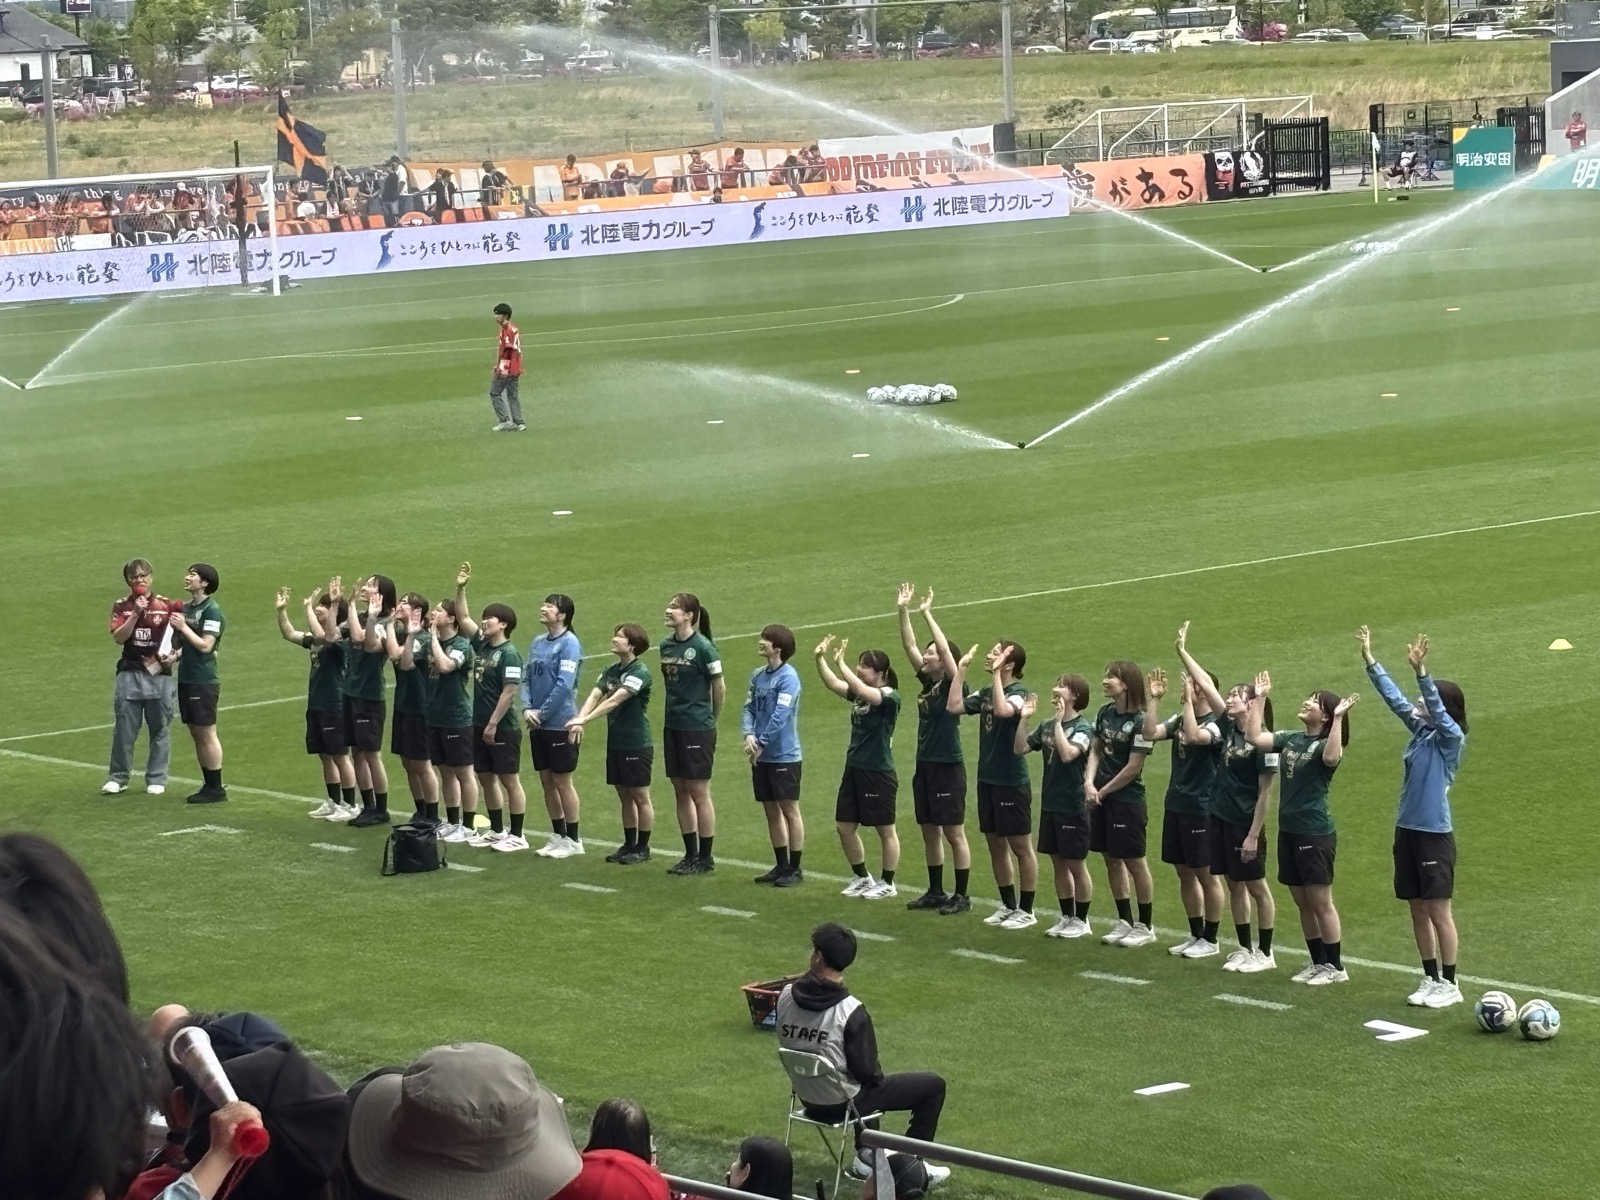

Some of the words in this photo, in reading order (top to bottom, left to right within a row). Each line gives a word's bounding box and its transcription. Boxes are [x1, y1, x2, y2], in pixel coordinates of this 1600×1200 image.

[1456, 152, 1511, 167] 明治安田
[933, 192, 1055, 217] 北陸電力グループ
[580, 217, 716, 246] 北陸電力グループ
[781, 1024, 830, 1044] STAFF
